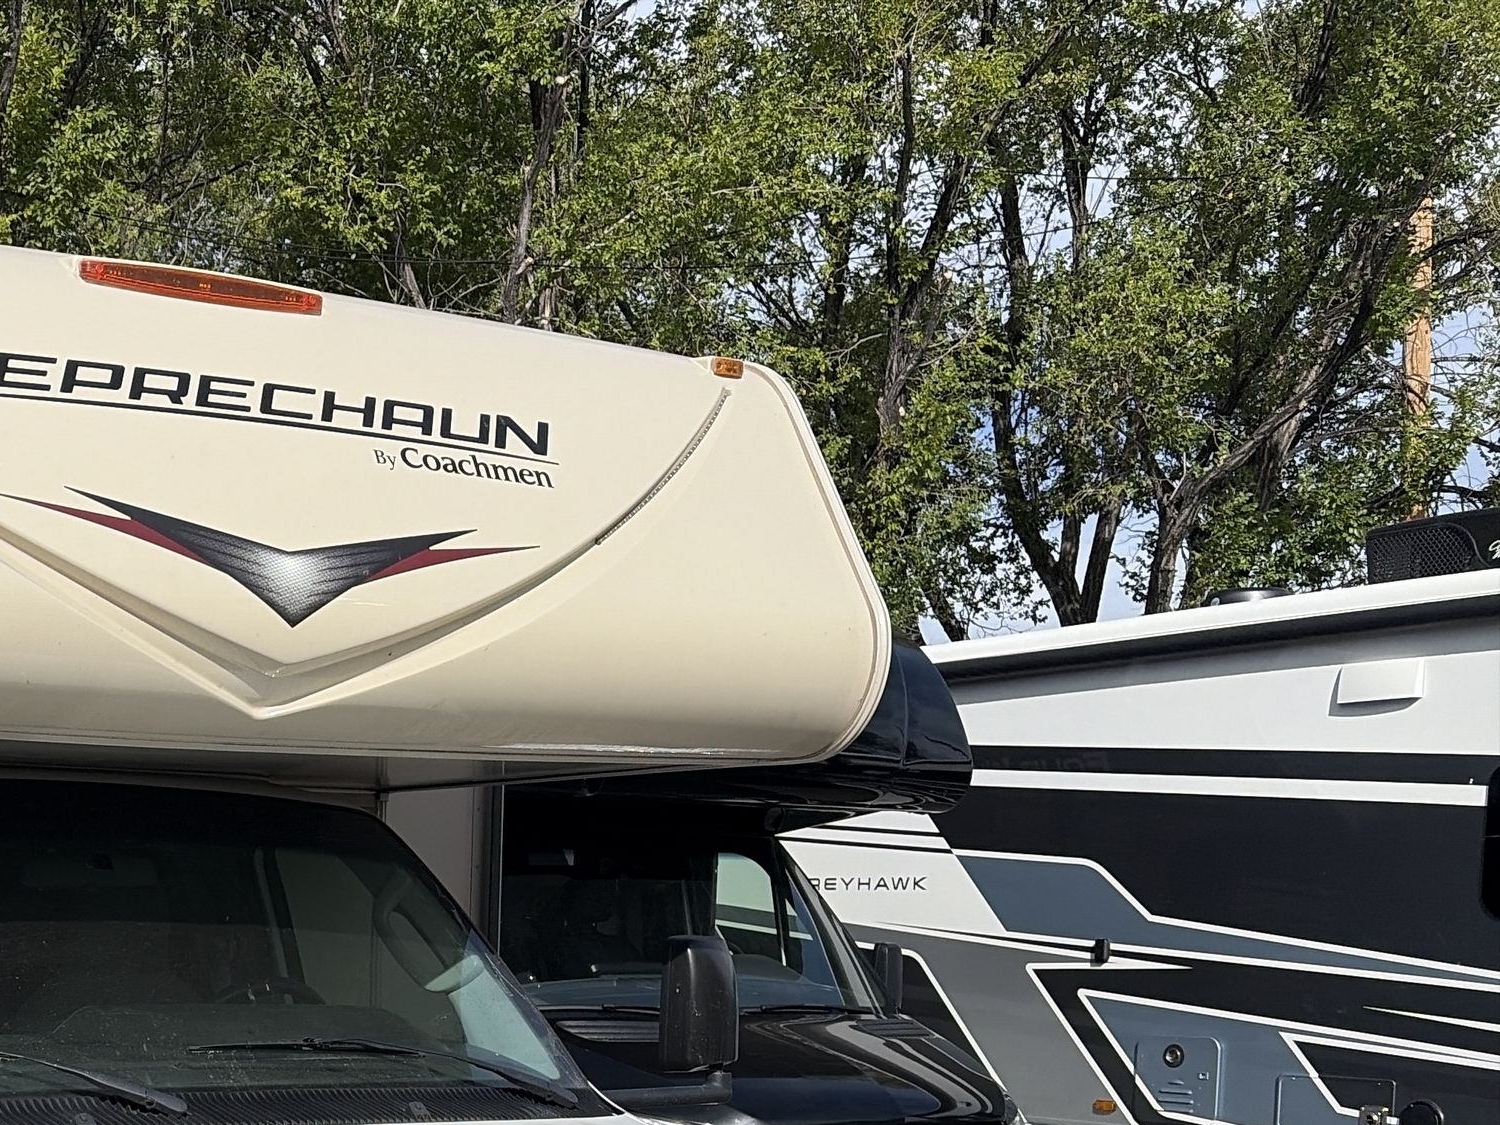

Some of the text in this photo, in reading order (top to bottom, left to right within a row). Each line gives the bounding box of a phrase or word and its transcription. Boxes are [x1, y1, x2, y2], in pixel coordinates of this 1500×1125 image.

[372, 447, 555, 489] By Coachmen
[808, 877, 928, 891] REYHAWK
